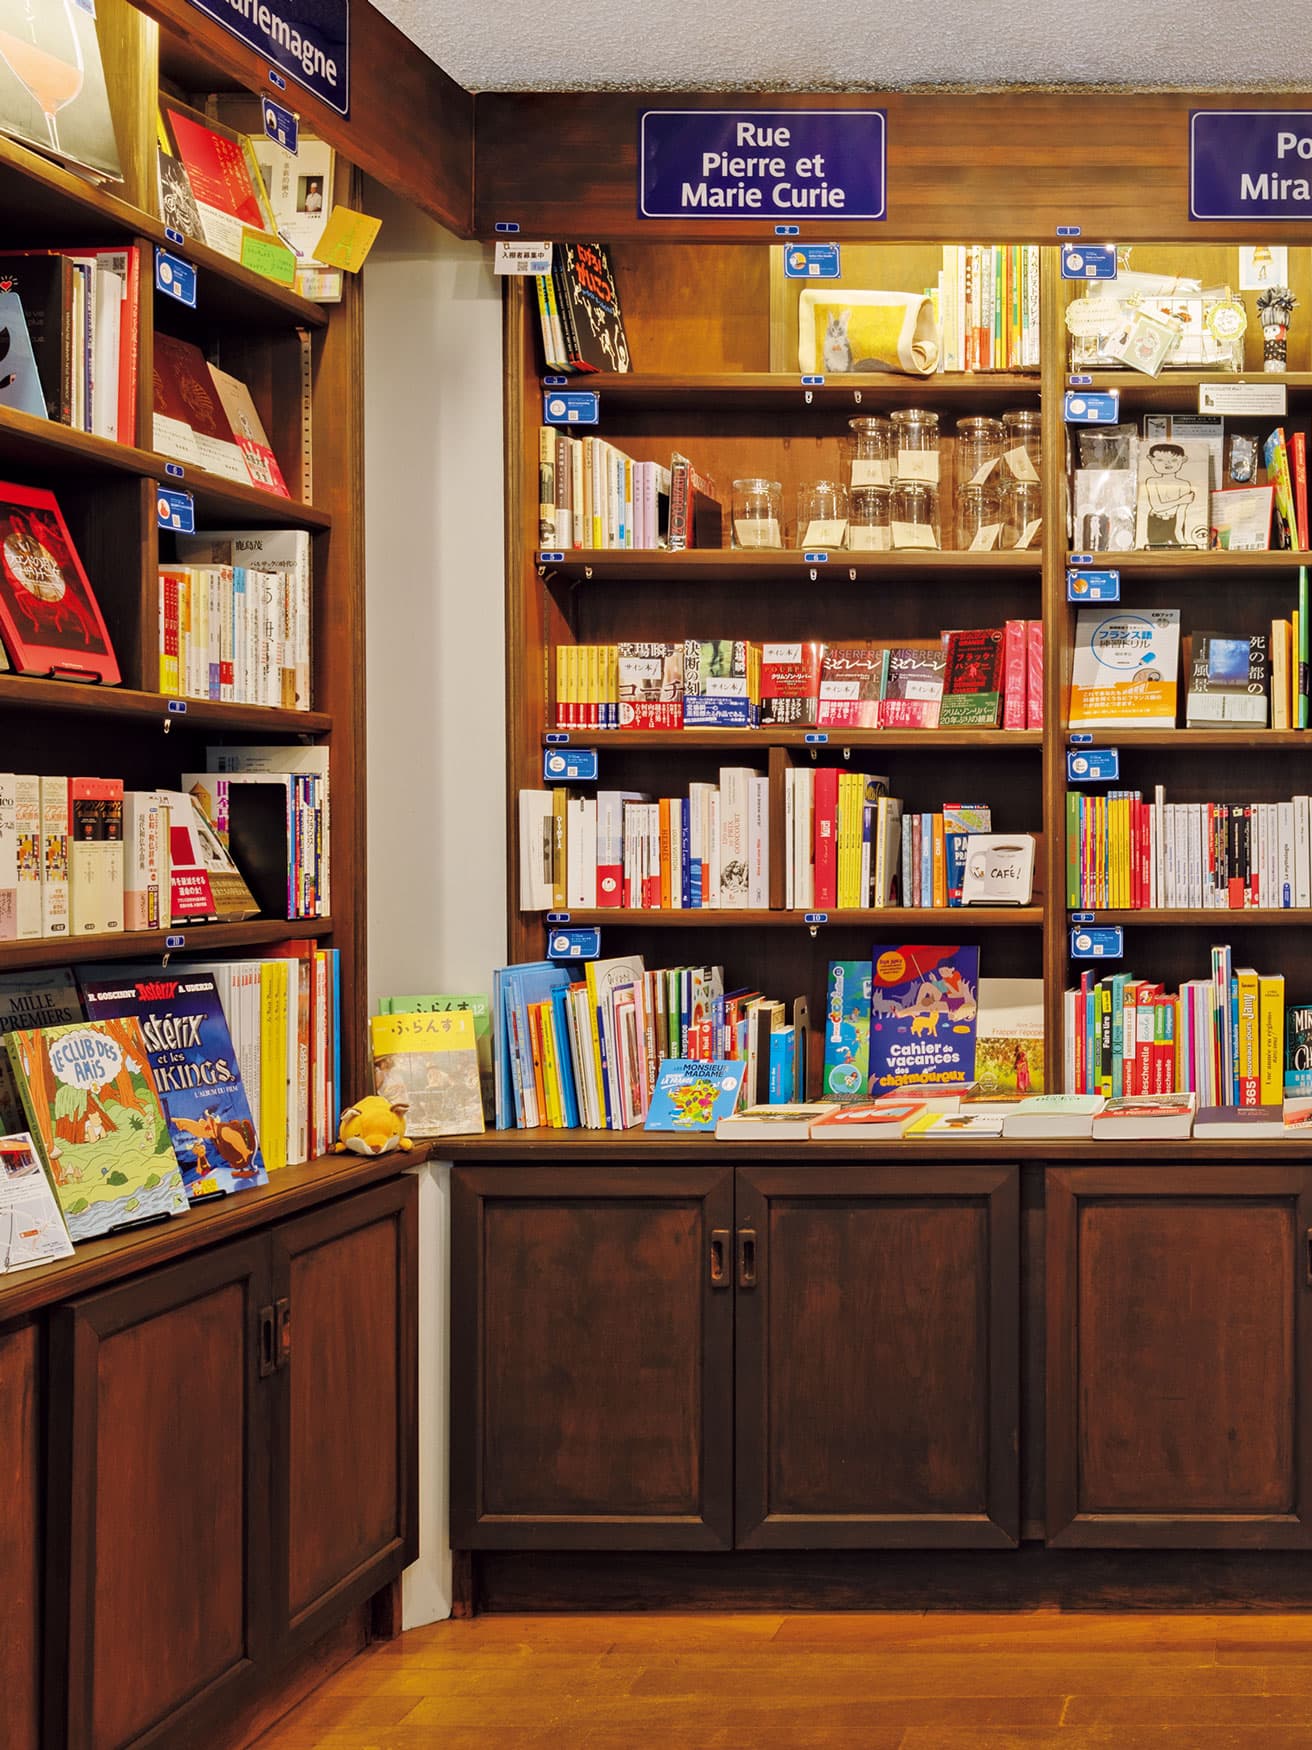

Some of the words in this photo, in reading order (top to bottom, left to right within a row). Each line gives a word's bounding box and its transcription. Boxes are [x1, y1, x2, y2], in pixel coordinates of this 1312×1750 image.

[226, 0, 337, 87] arlemagne
[736, 123, 790, 146] Rue
[702, 151, 785, 177] Pierre
[796, 155, 825, 177] et
[681, 182, 762, 208] Marie
[772, 182, 845, 208] Curie
[9, 994, 56, 1014] MILLE
[0, 1008, 73, 1031] PREMIERS
[391, 1018, 453, 1036] ふらんす
[52, 1052, 65, 1073] LE
[61, 1037, 94, 1063] CLUB
[97, 1040, 118, 1063] DES
[158, 1054, 168, 1063] et
[886, 1053, 960, 1067] vacances
[890, 1041, 942, 1056] Cahier
[154, 1058, 236, 1093] IKINGS
[1141, 1046, 1150, 1096] Bescherelle
[1245, 1080, 1256, 1105] 365
